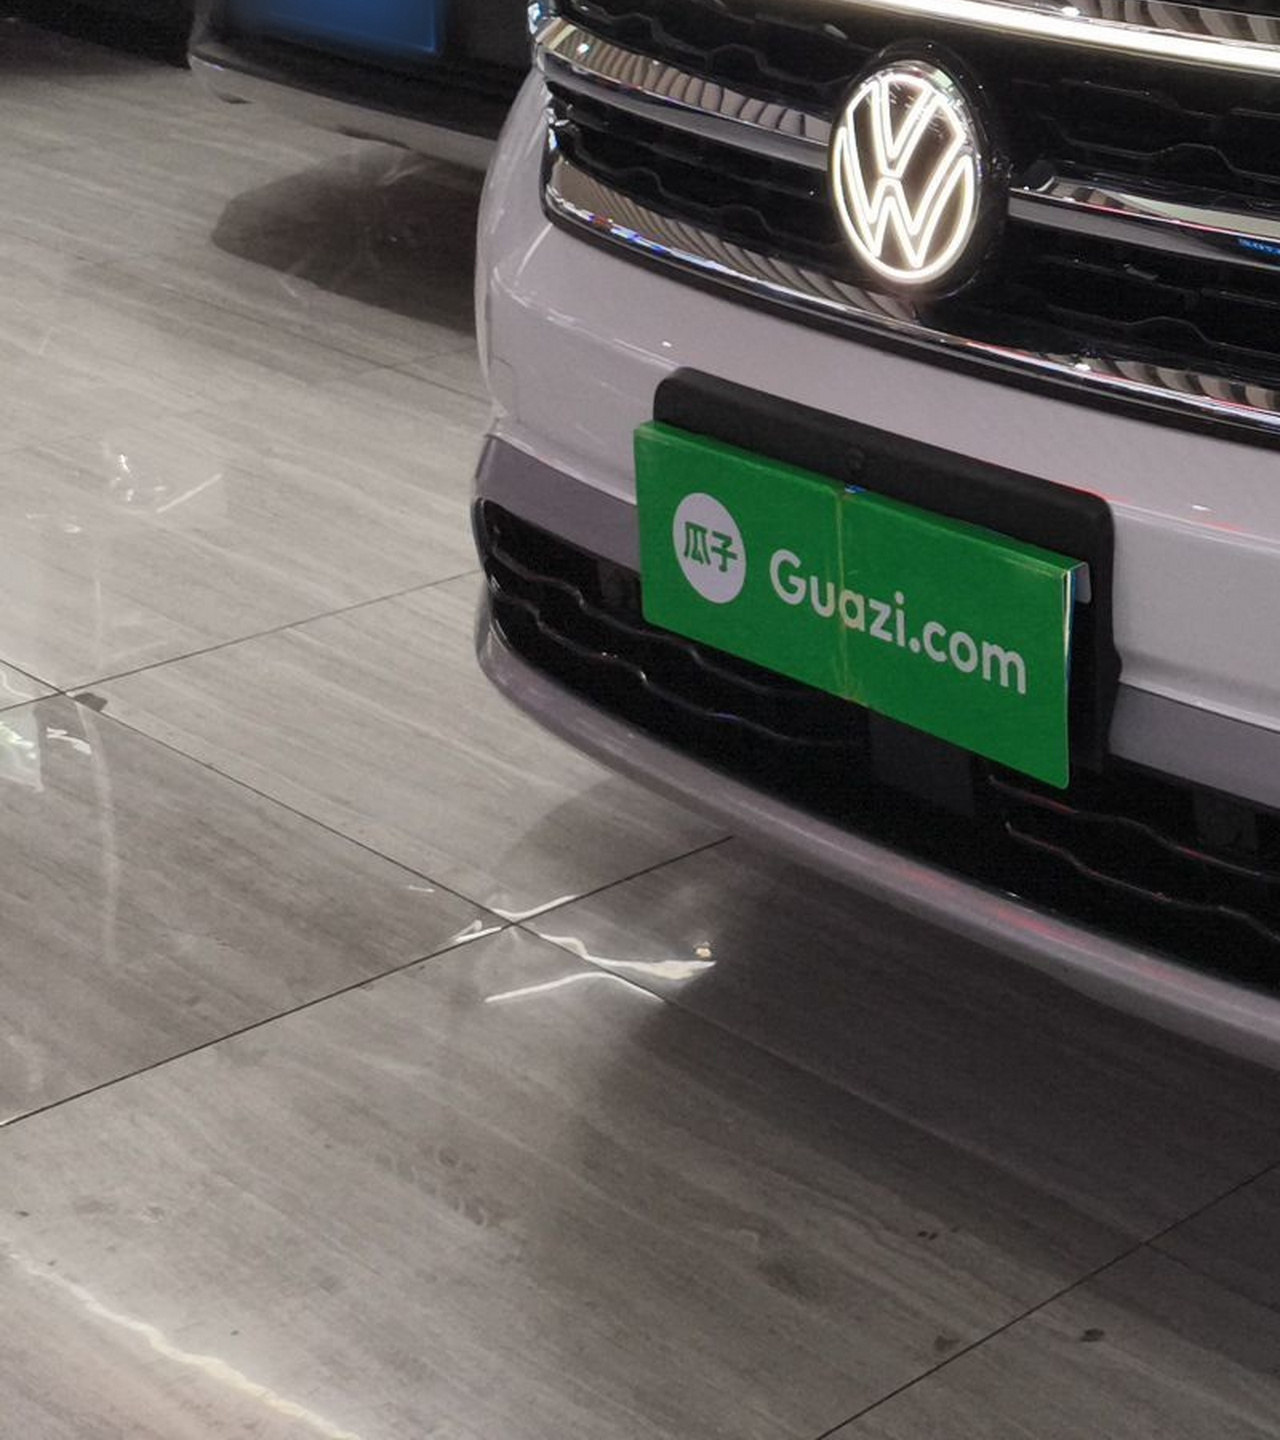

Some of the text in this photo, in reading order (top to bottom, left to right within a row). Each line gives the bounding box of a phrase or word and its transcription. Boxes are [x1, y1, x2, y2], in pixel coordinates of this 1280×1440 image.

[834, 71, 976, 281] VW
[683, 521, 738, 573] 瓜子
[769, 549, 1027, 695] Guazi.com
